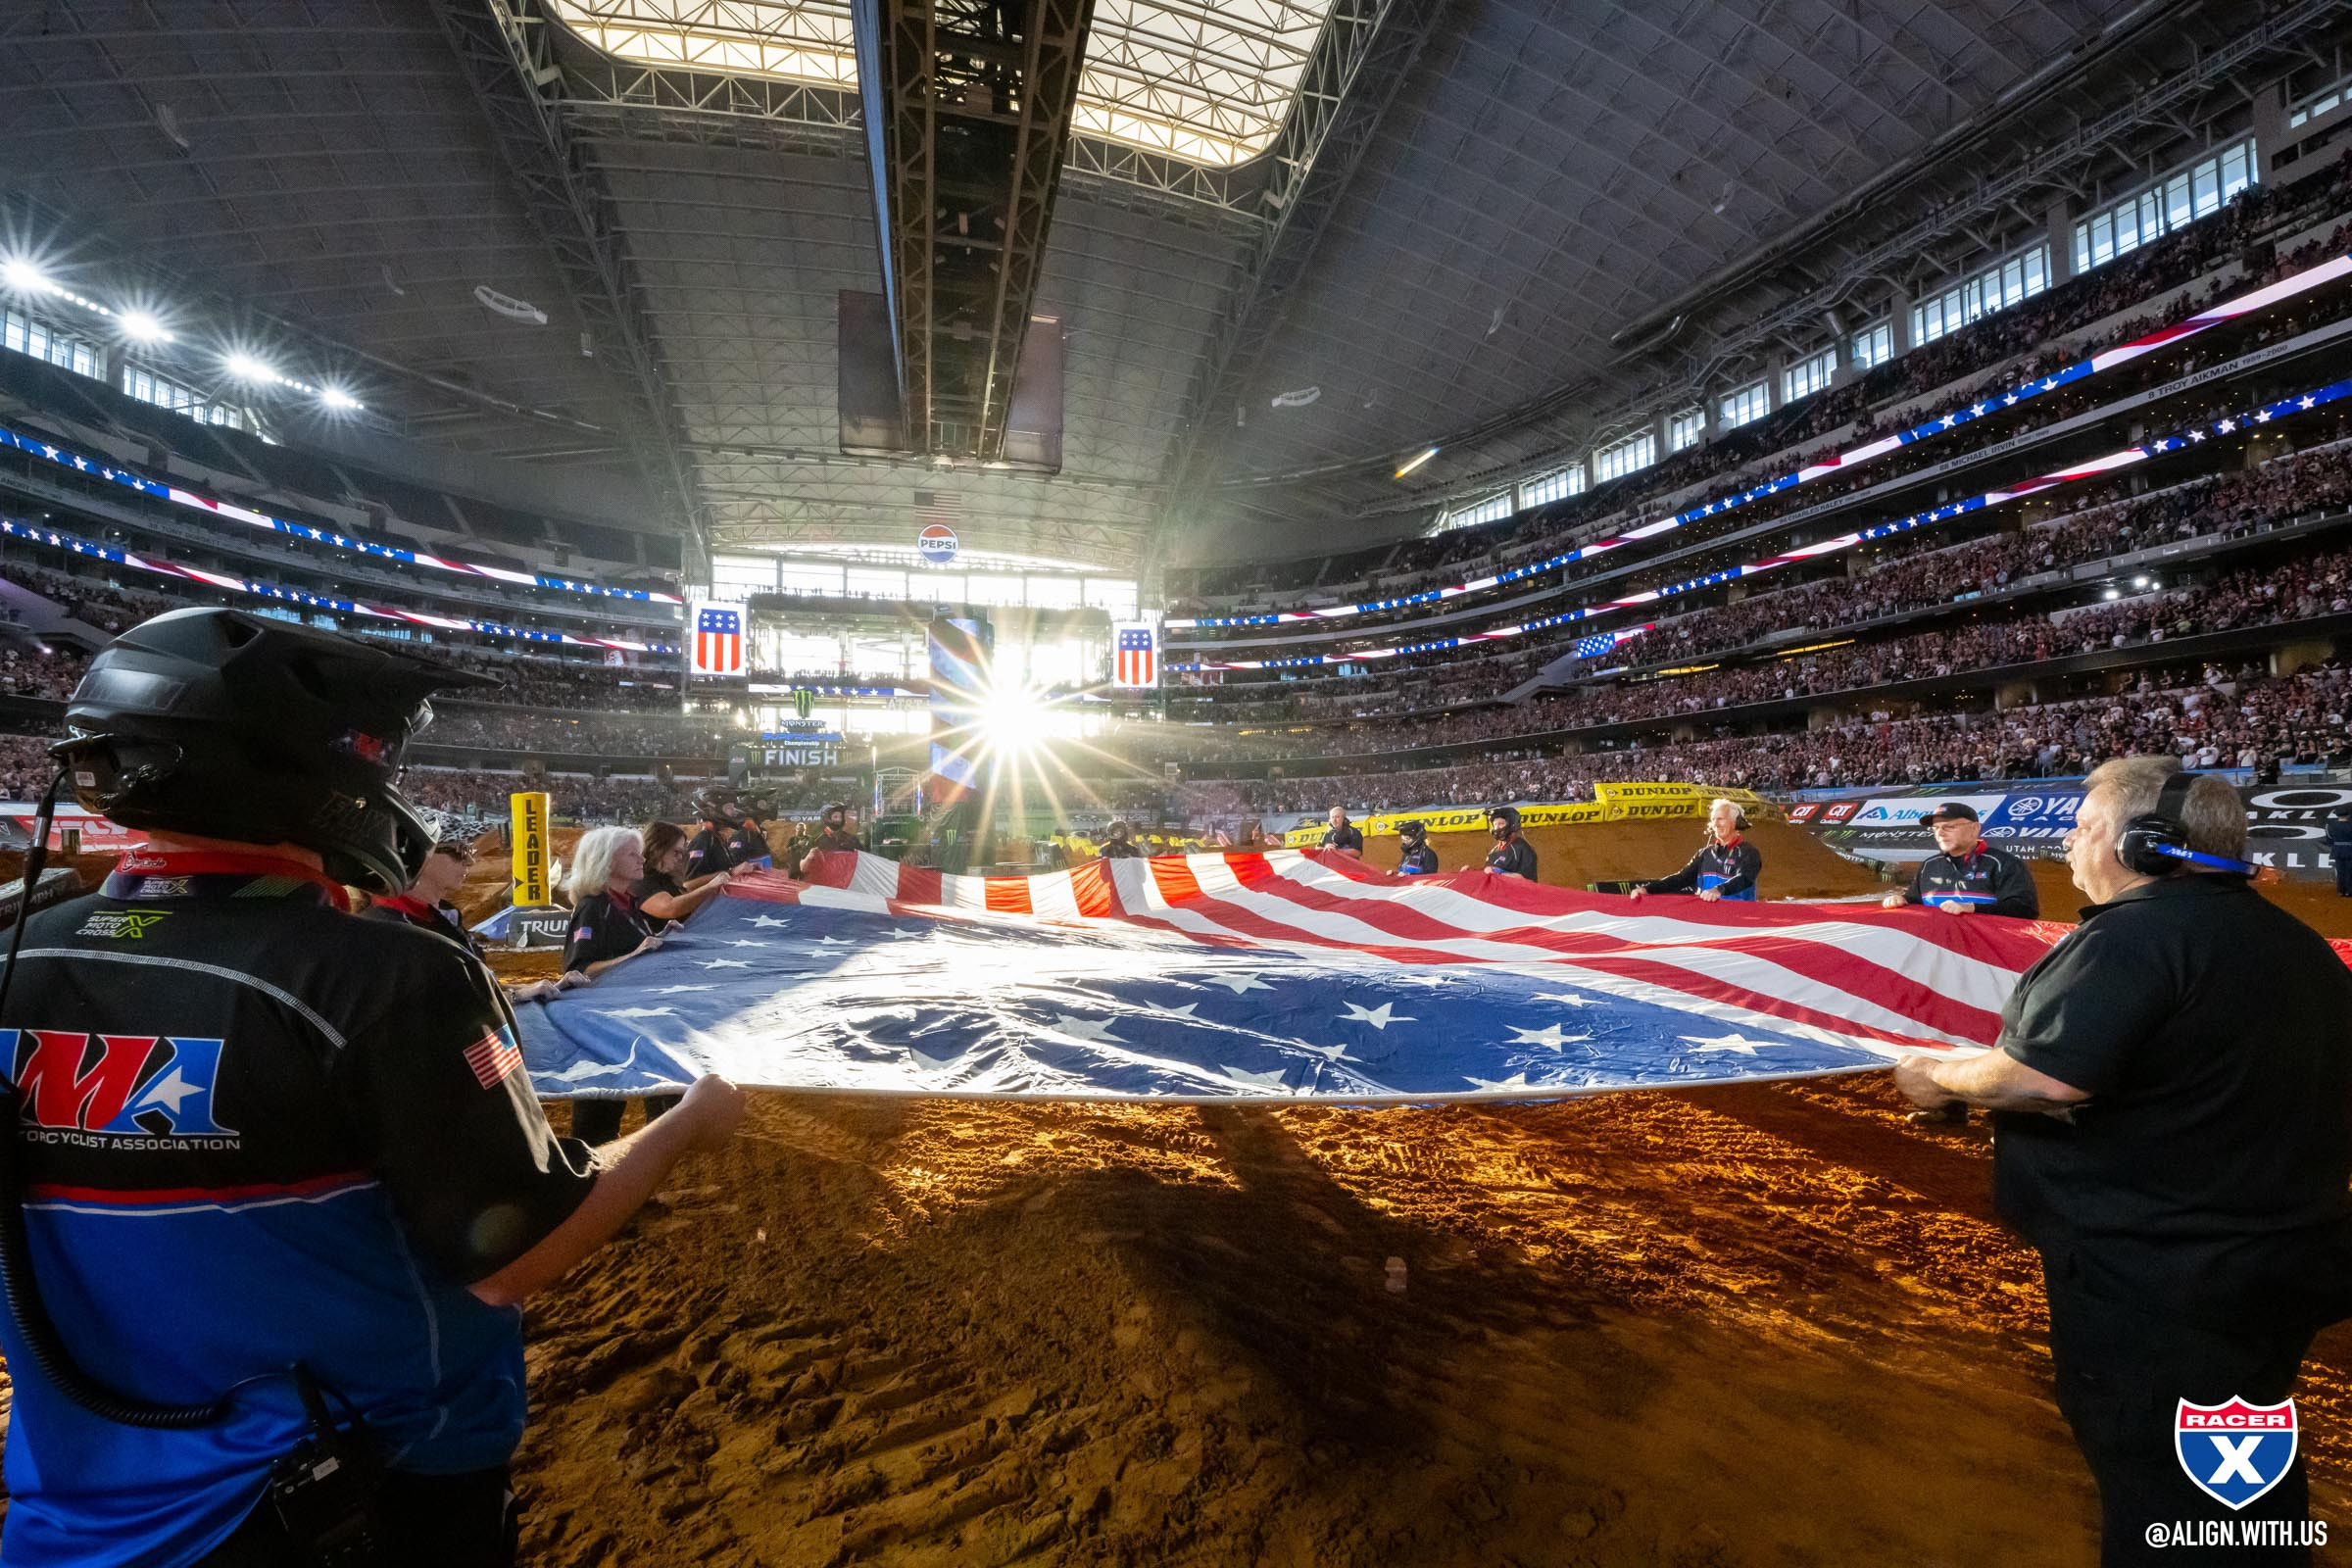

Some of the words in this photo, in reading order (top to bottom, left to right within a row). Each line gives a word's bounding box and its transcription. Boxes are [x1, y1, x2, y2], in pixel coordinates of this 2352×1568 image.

[2148, 391, 2155, 400] 8
[2158, 380, 2187, 395] TROY
[2191, 361, 2238, 385] AIKMAN
[1951, 450, 1989, 467] MICHAEL
[1991, 440, 2016, 454] IRVIN
[920, 539, 956, 550] PEPSI
[764, 749, 838, 766] FINISH
[1622, 787, 1692, 797] DUNLOP
[1628, 805, 1695, 817] DUNLOP
[1792, 806, 1816, 816] QT
[1828, 805, 1853, 816] QT
[1520, 810, 1600, 825] DUNLOP
[525, 799, 541, 901] LEADER
[86, 914, 128, 923] SUPER
[520, 920, 569, 932] TRIU
[18, 1130, 108, 1149] ORCYCLIST
[111, 1138, 241, 1152] ASSOCIATION
